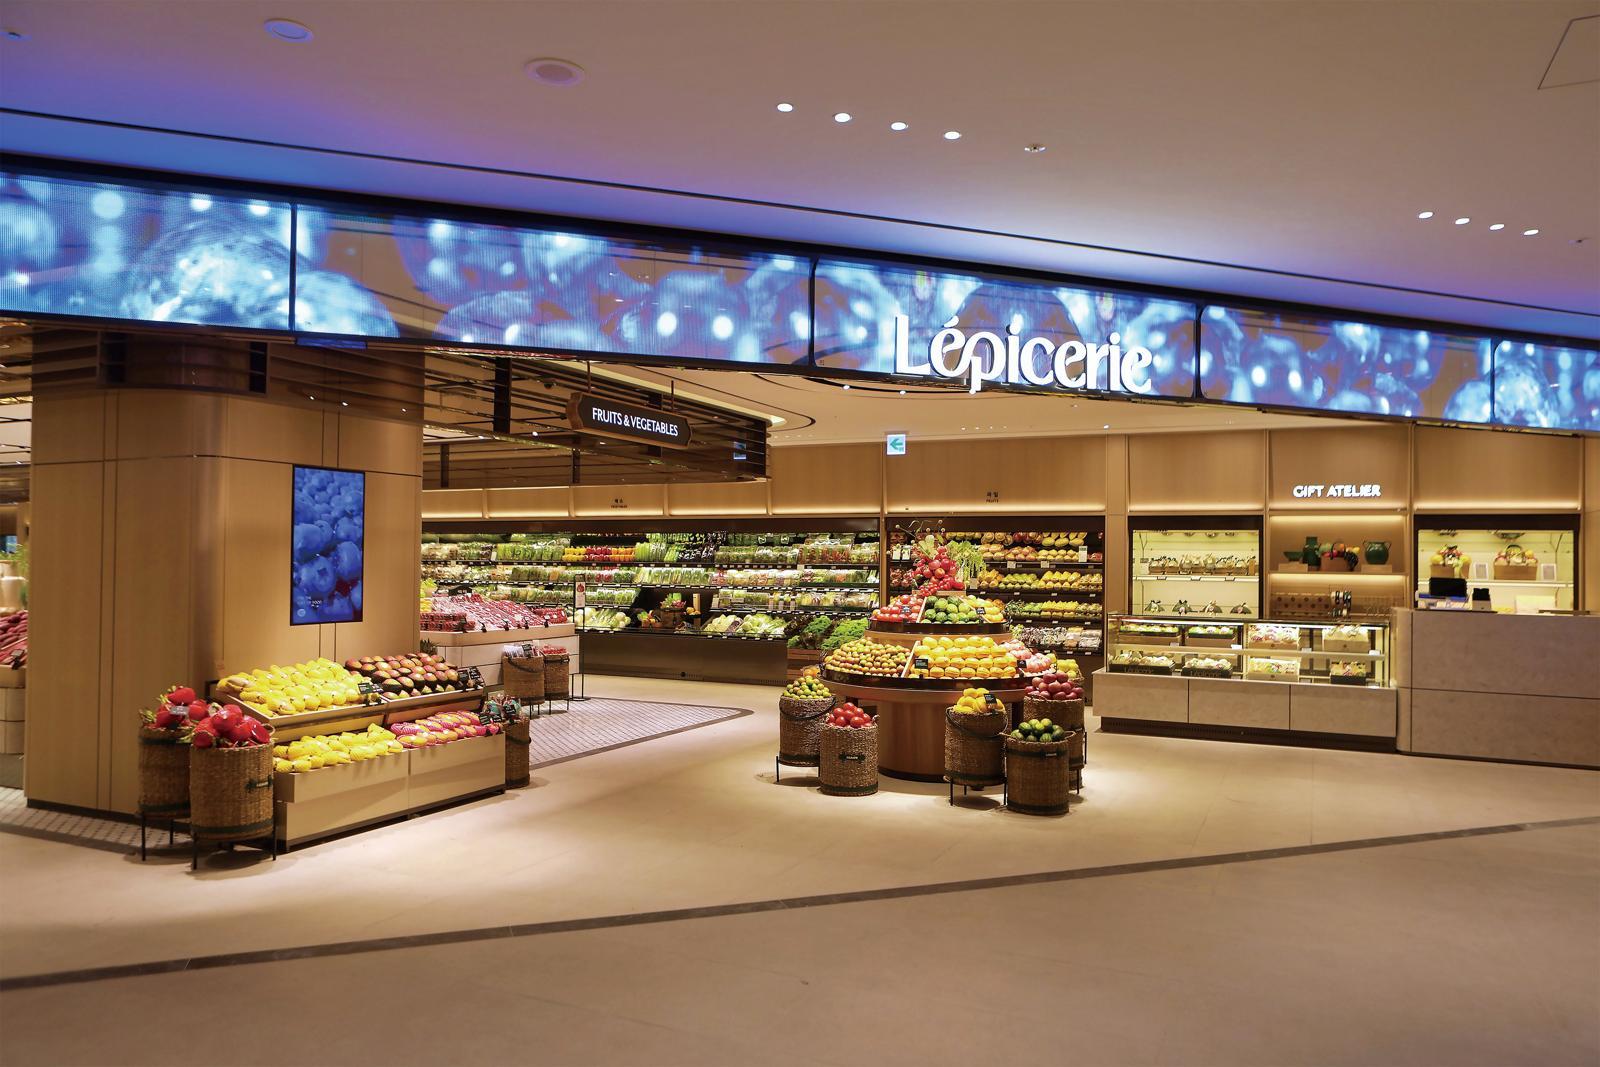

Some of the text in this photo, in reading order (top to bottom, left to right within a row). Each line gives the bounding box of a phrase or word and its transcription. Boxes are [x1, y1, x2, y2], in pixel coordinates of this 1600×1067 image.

[592, 407, 679, 437] FRUITS & VEGETABLES
[1292, 484, 1382, 498] GIFT ATELIER
